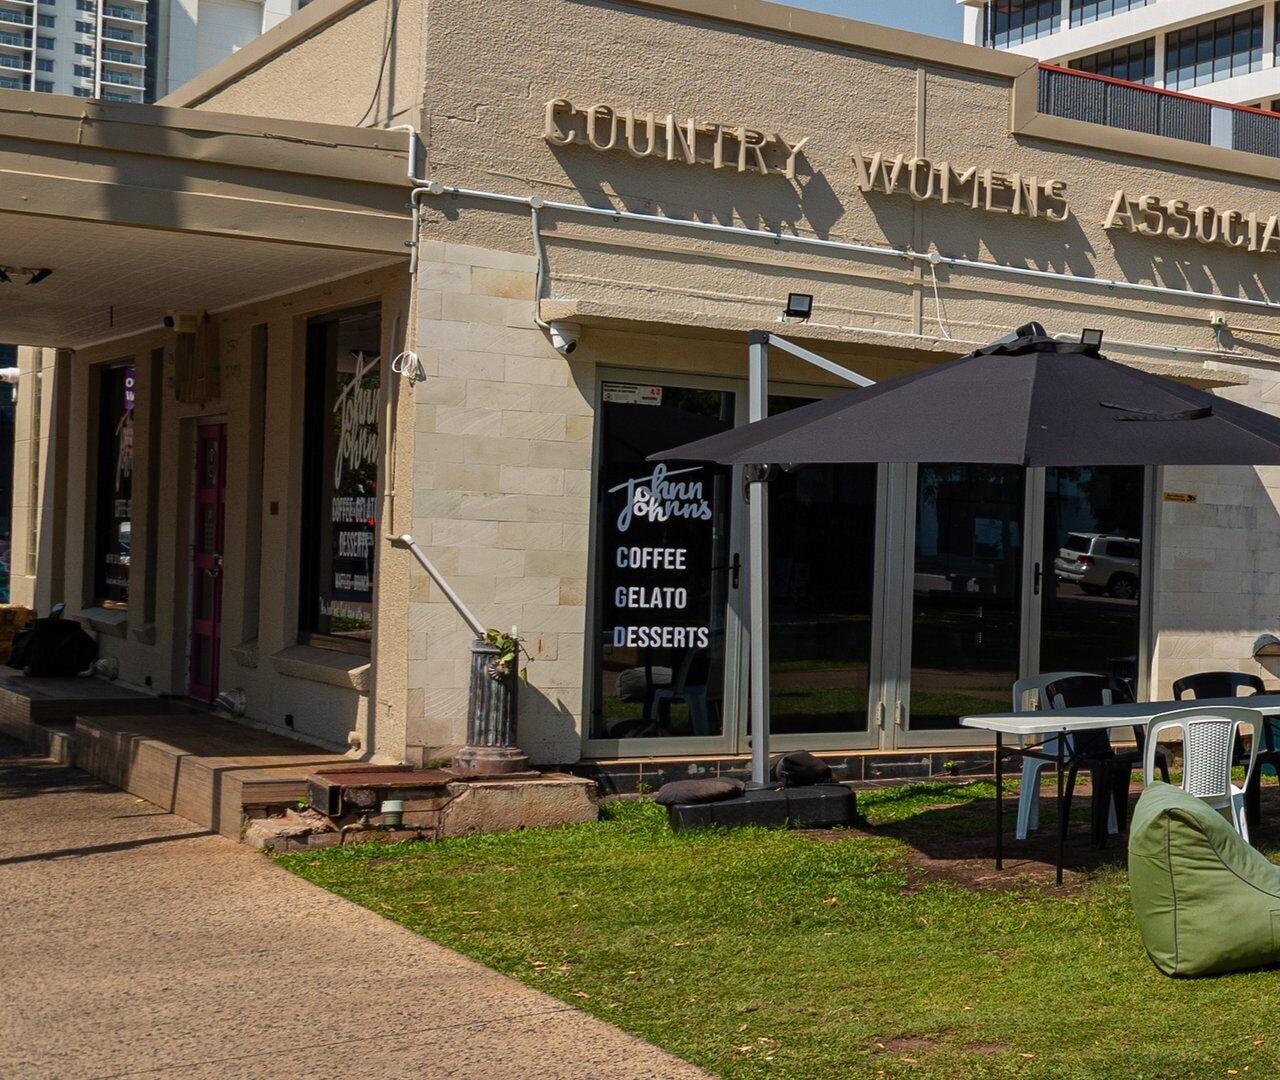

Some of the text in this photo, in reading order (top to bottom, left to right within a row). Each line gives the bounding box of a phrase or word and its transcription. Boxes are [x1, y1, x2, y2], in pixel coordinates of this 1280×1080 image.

[545, 97, 809, 179] COUNTRY
[851, 143, 1070, 222] WOMENS
[616, 546, 687, 570] COFFEE
[614, 586, 687, 609] GELATO
[613, 626, 710, 648] DESSERTS
